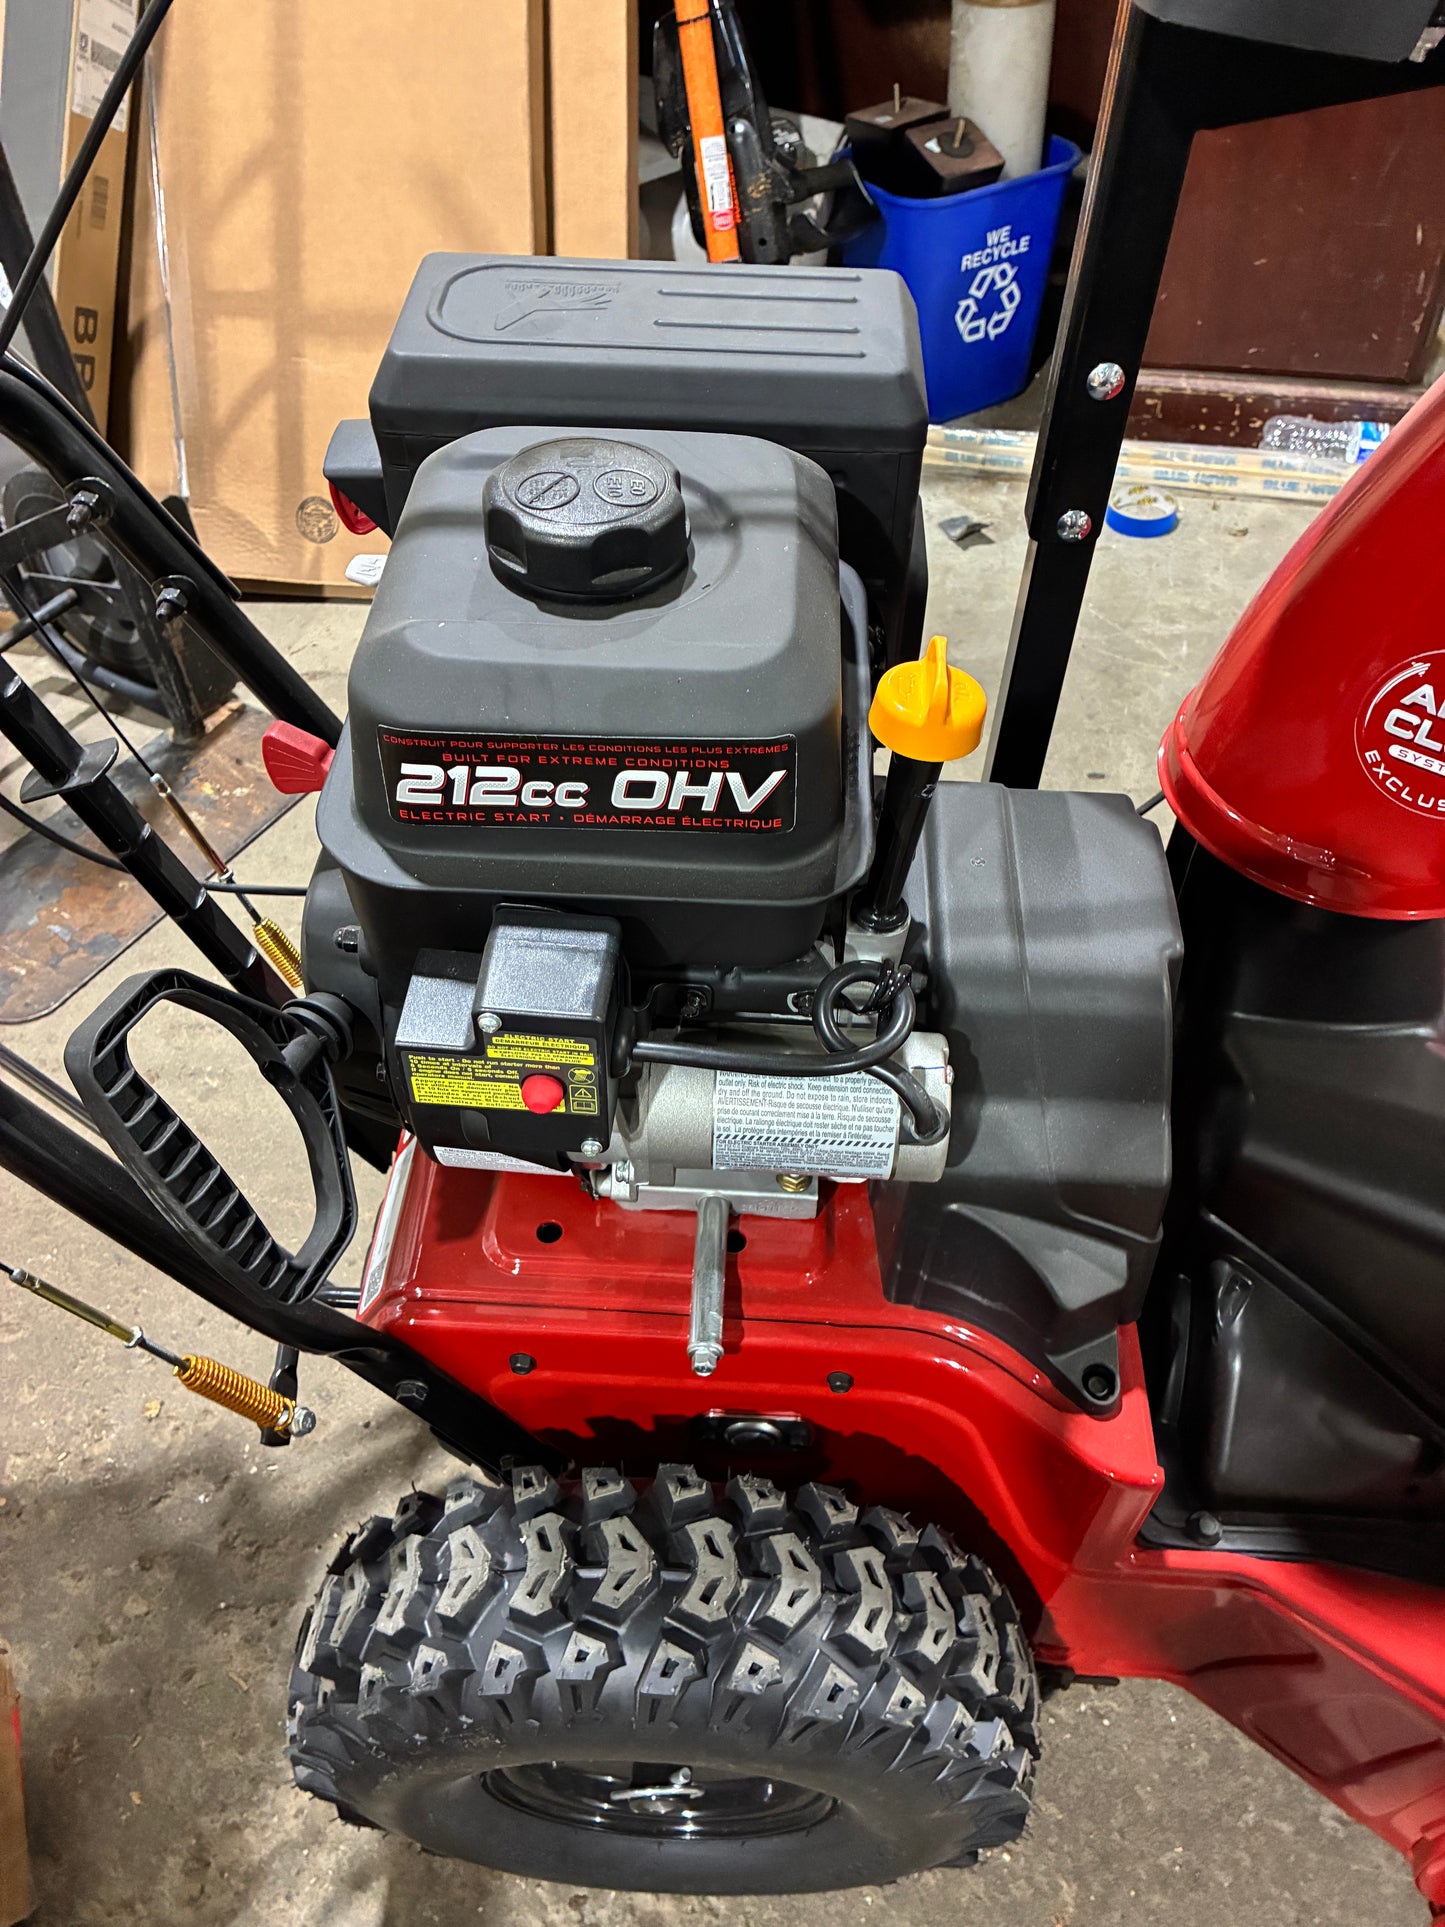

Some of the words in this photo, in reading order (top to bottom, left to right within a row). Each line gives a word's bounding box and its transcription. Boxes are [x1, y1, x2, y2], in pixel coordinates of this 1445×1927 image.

[986, 225, 1012, 247] WE
[960, 235, 1031, 272] RECYCLE
[1399, 683, 1445, 720] A
[1383, 708, 1445, 754] CL
[383, 734, 446, 748] CONSTRUIT
[450, 741, 484, 749] POUR
[487, 741, 559, 751] SUPPORTER
[562, 743, 584, 752] LES
[589, 744, 662, 753] CONDITIONS
[665, 746, 687, 754] LES
[691, 746, 722, 755] PLUS
[442, 752, 489, 763] BUILT
[497, 754, 531, 764] FOR
[538, 755, 618, 766] EXTREME
[625, 757, 730, 769] CONDITIONS
[396, 762, 590, 809] 212cc
[610, 769, 788, 814] OHV
[399, 809, 486, 821] ELECTRIC
[494, 812, 551, 822] START
[573, 812, 676, 825] DÉMARRAGE
[681, 815, 782, 829] ÉLECTRIQUE
[504, 1033, 545, 1041] ELECTRIC
[808, 1084, 822, 1092] Keep
[845, 1077, 866, 1085] properly
[718, 1089, 727, 1097] dry
[838, 1095, 851, 1103] rain,
[838, 1114, 855, 1122] Risque
[876, 1106, 894, 1114] qu'une
[776, 1120, 802, 1128] électrique
